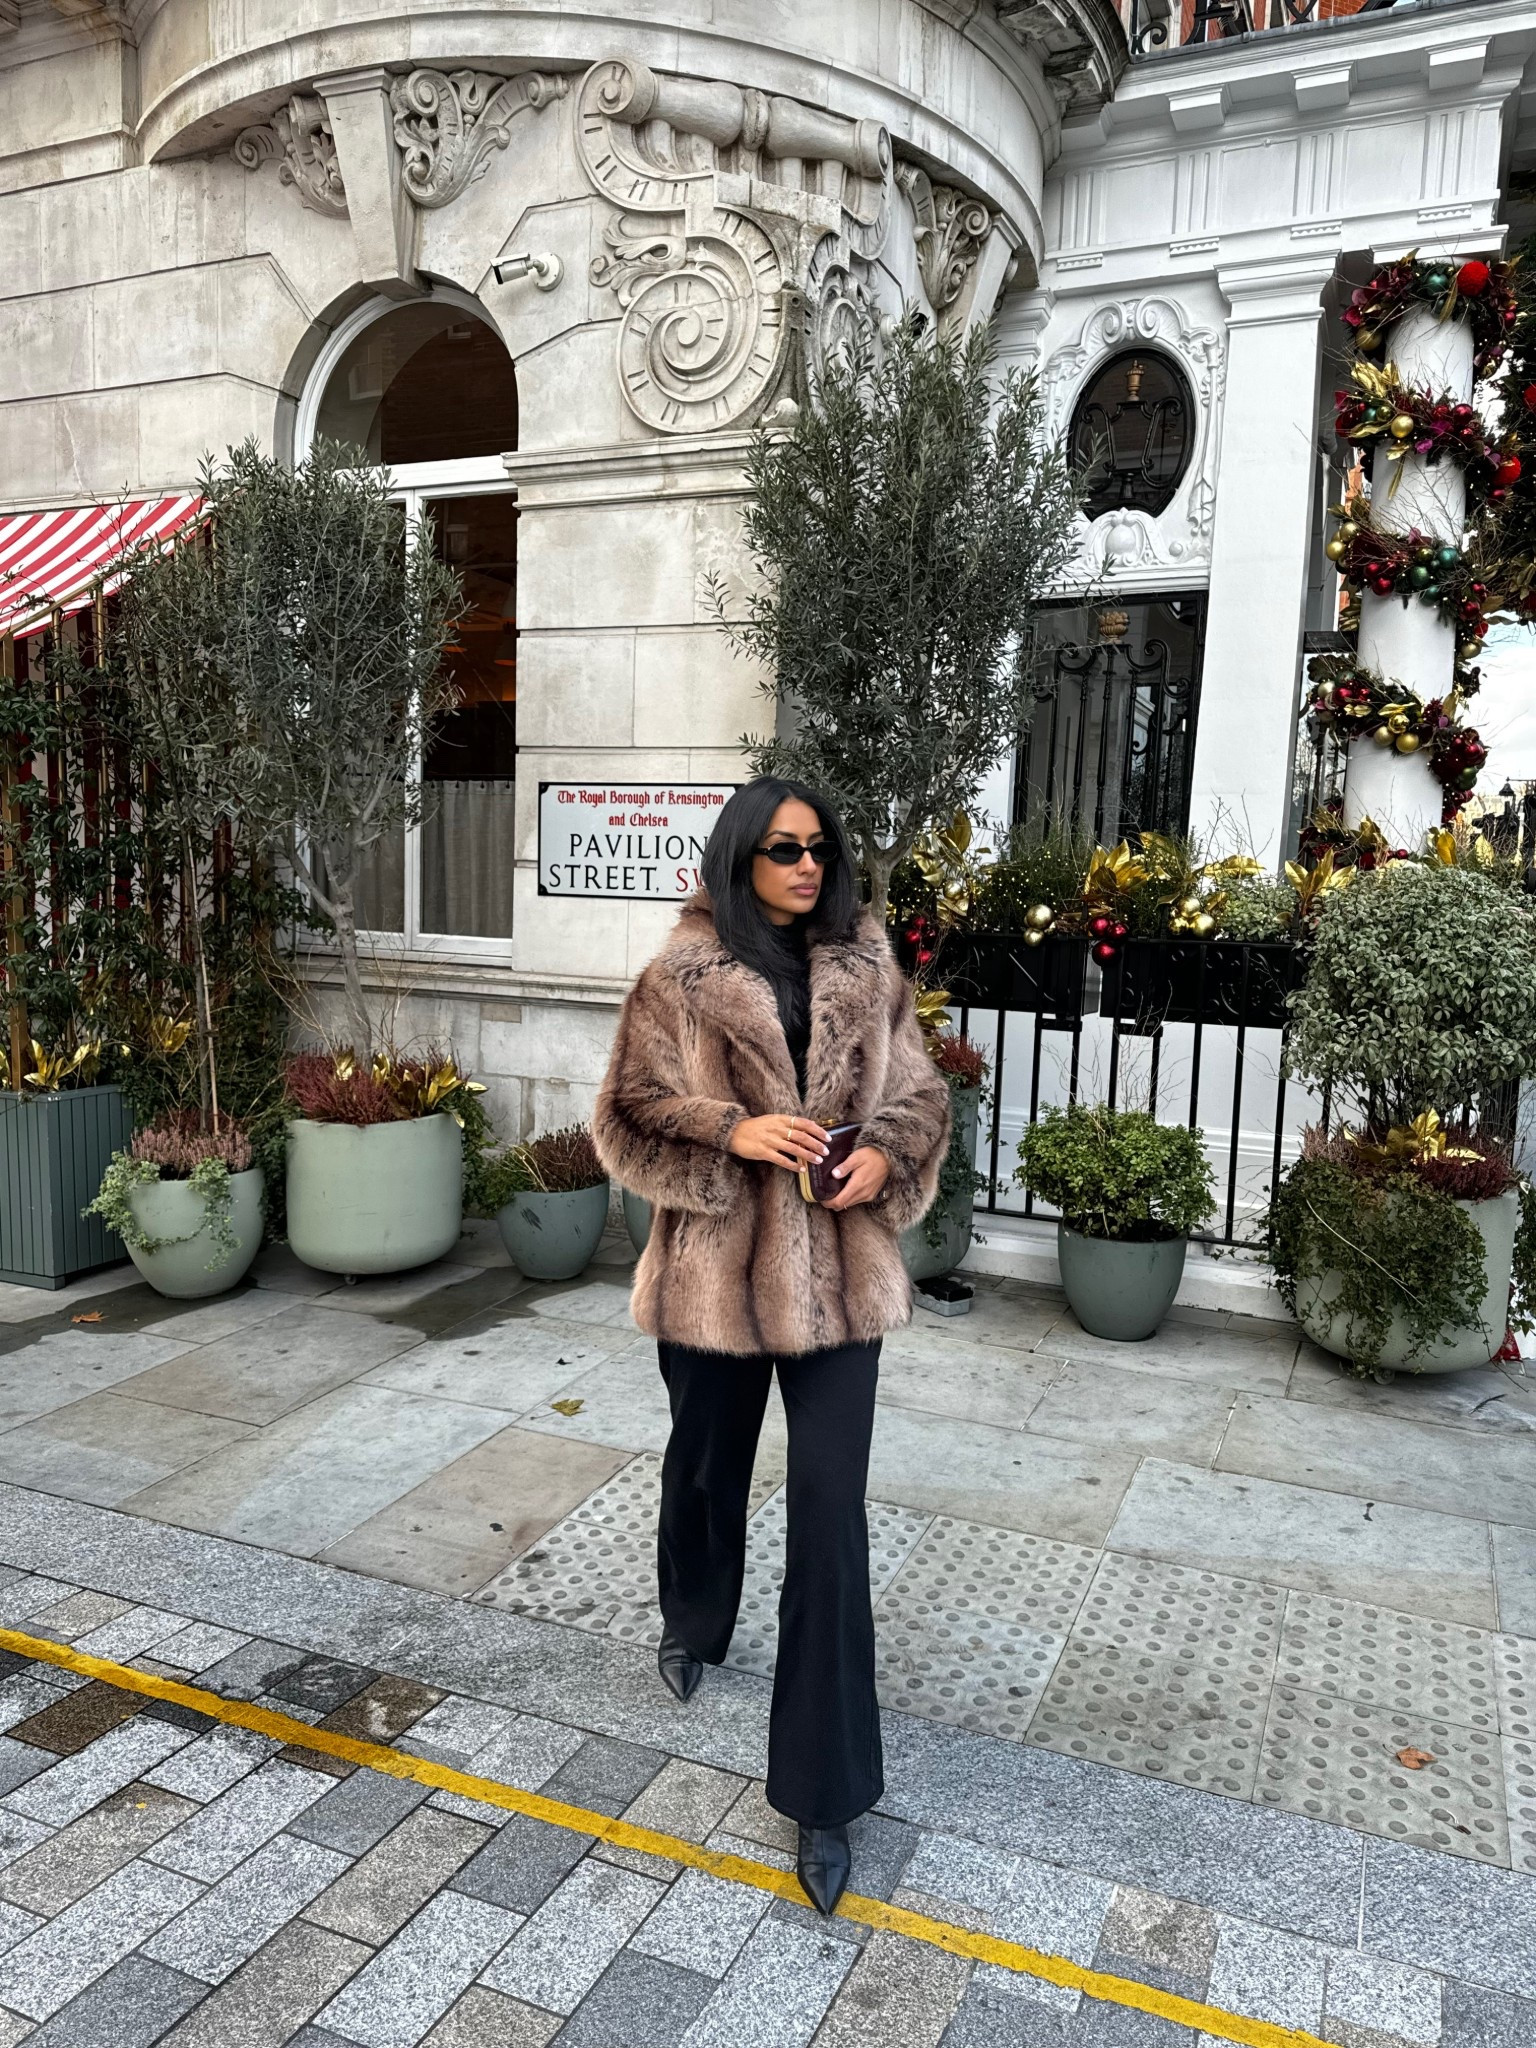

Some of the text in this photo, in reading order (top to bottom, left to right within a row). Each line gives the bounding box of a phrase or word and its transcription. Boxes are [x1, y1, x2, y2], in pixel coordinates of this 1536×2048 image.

[558, 790, 724, 808] The Royal Borough of Kensington
[608, 813, 669, 827] and Chelsea
[569, 833, 708, 860] PAVILION
[549, 864, 660, 893] STREET,
